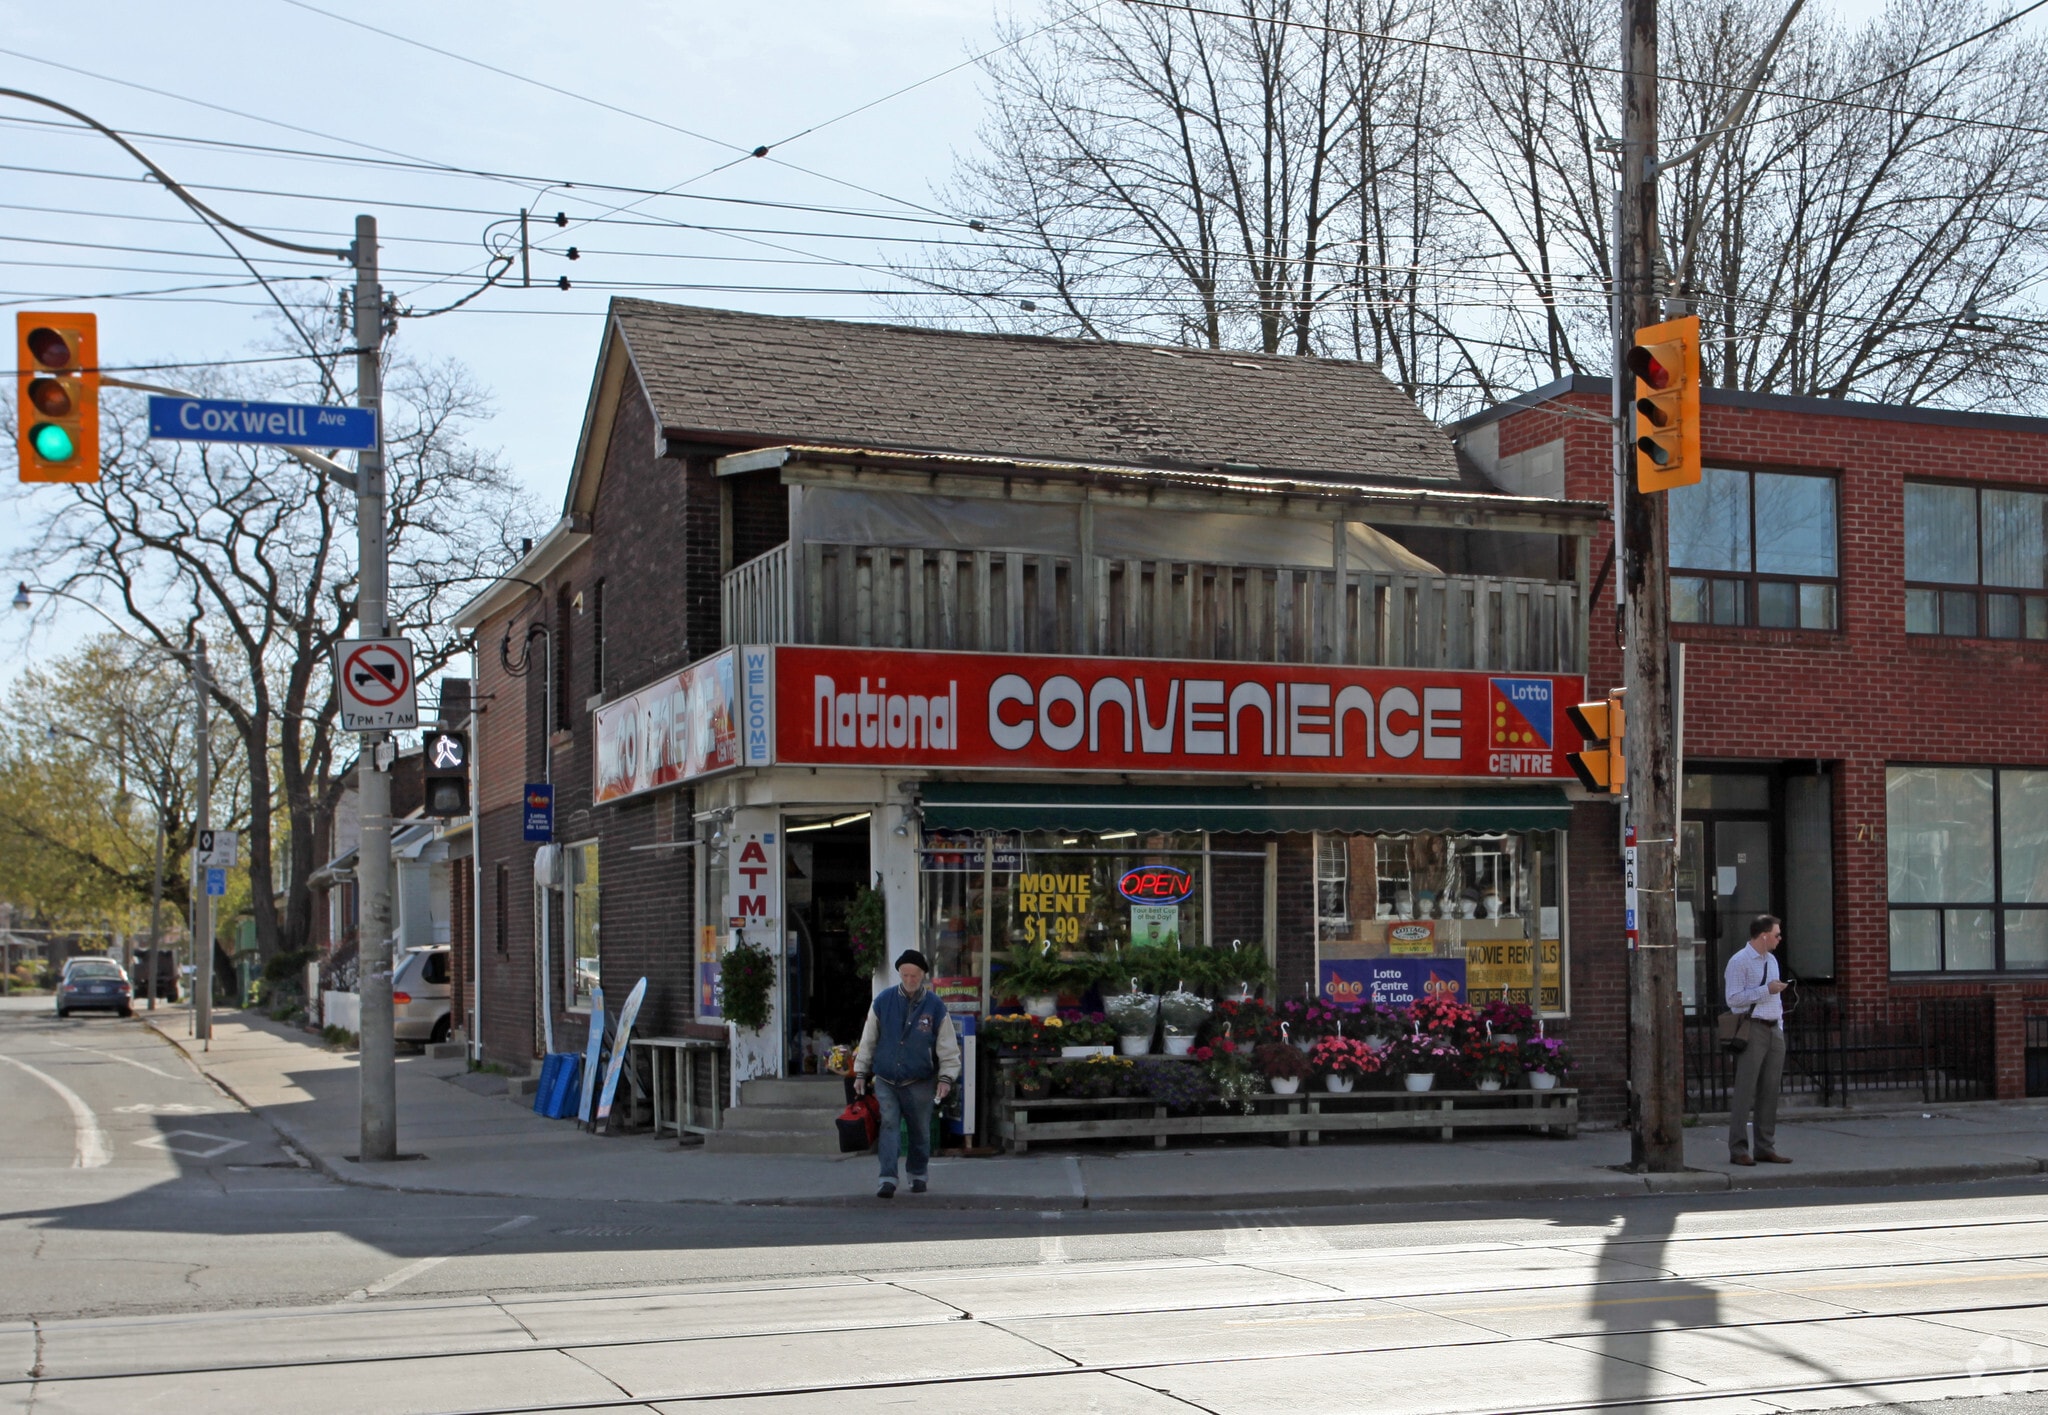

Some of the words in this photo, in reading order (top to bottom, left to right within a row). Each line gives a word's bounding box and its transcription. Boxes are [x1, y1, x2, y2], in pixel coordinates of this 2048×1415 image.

[179, 402, 307, 436] Coxwell
[317, 410, 346, 426] Ave
[1511, 684, 1548, 701] Lotto
[747, 654, 767, 760] WELCOME
[814, 674, 958, 750] National
[987, 673, 1463, 760] CONVENIENCE
[1488, 753, 1553, 774] CENTRE
[738, 841, 768, 917] ATM
[1020, 873, 1091, 894] MOVIE
[1121, 873, 1192, 896] OPEN
[1020, 894, 1091, 914] RENT
[1163, 907, 1177, 915] Cup
[1468, 945, 1504, 965] MOVIE
[1373, 968, 1402, 979] Lotto
[1374, 981, 1409, 991] Centre
[1374, 992, 1387, 1003] de
[1390, 992, 1414, 1003] Loto
